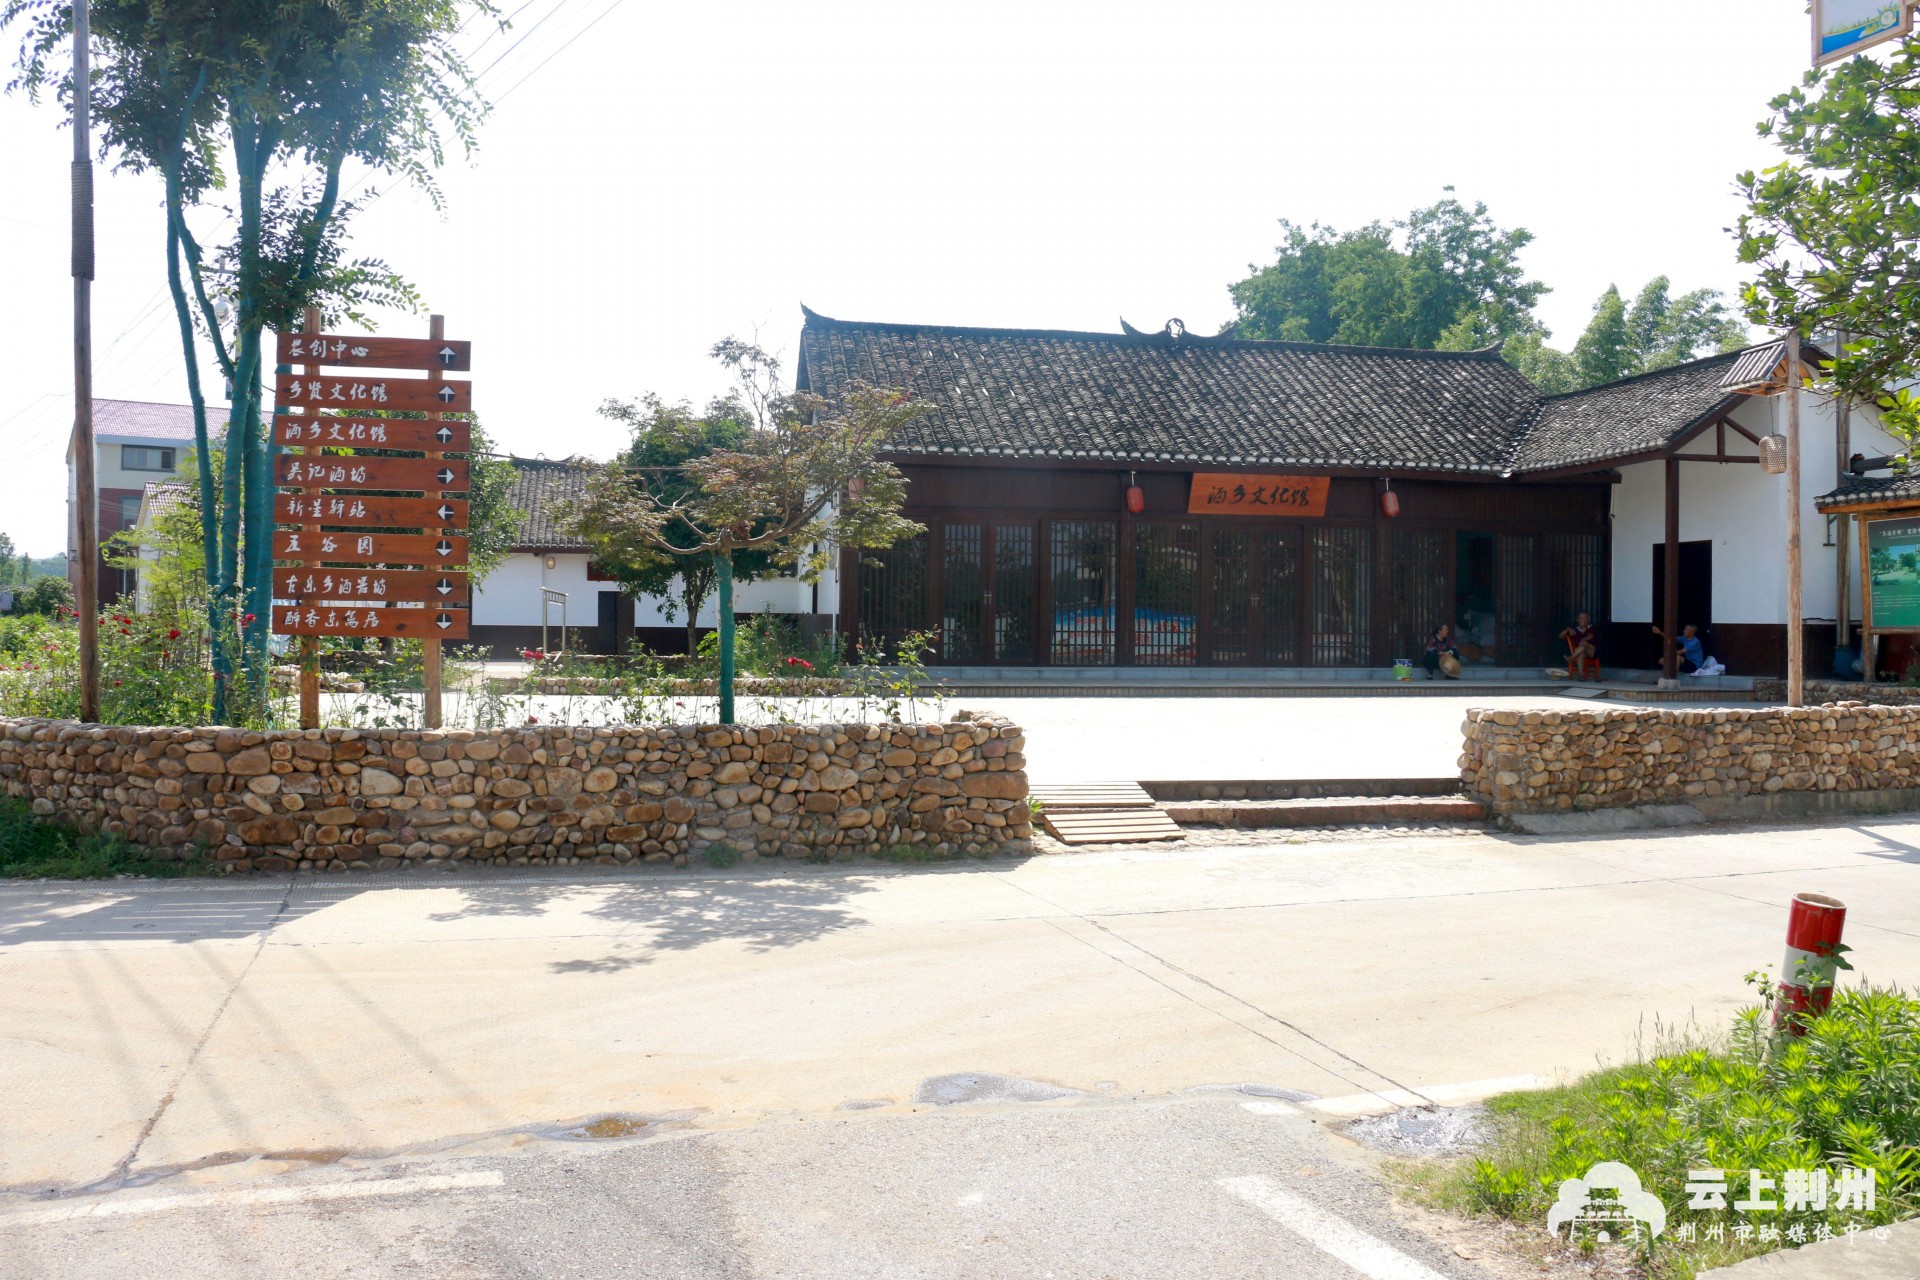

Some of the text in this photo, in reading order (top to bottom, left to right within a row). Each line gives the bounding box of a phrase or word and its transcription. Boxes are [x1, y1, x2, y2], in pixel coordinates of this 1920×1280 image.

[289, 381, 388, 402] 乡贤文化馆
[286, 421, 387, 442] 酒乡文化馆
[287, 463, 366, 483] 吴记酒坊
[1207, 484, 1310, 506] 酒乡文化馆
[286, 498, 366, 518] 新星驿站
[285, 535, 373, 555] 五谷园
